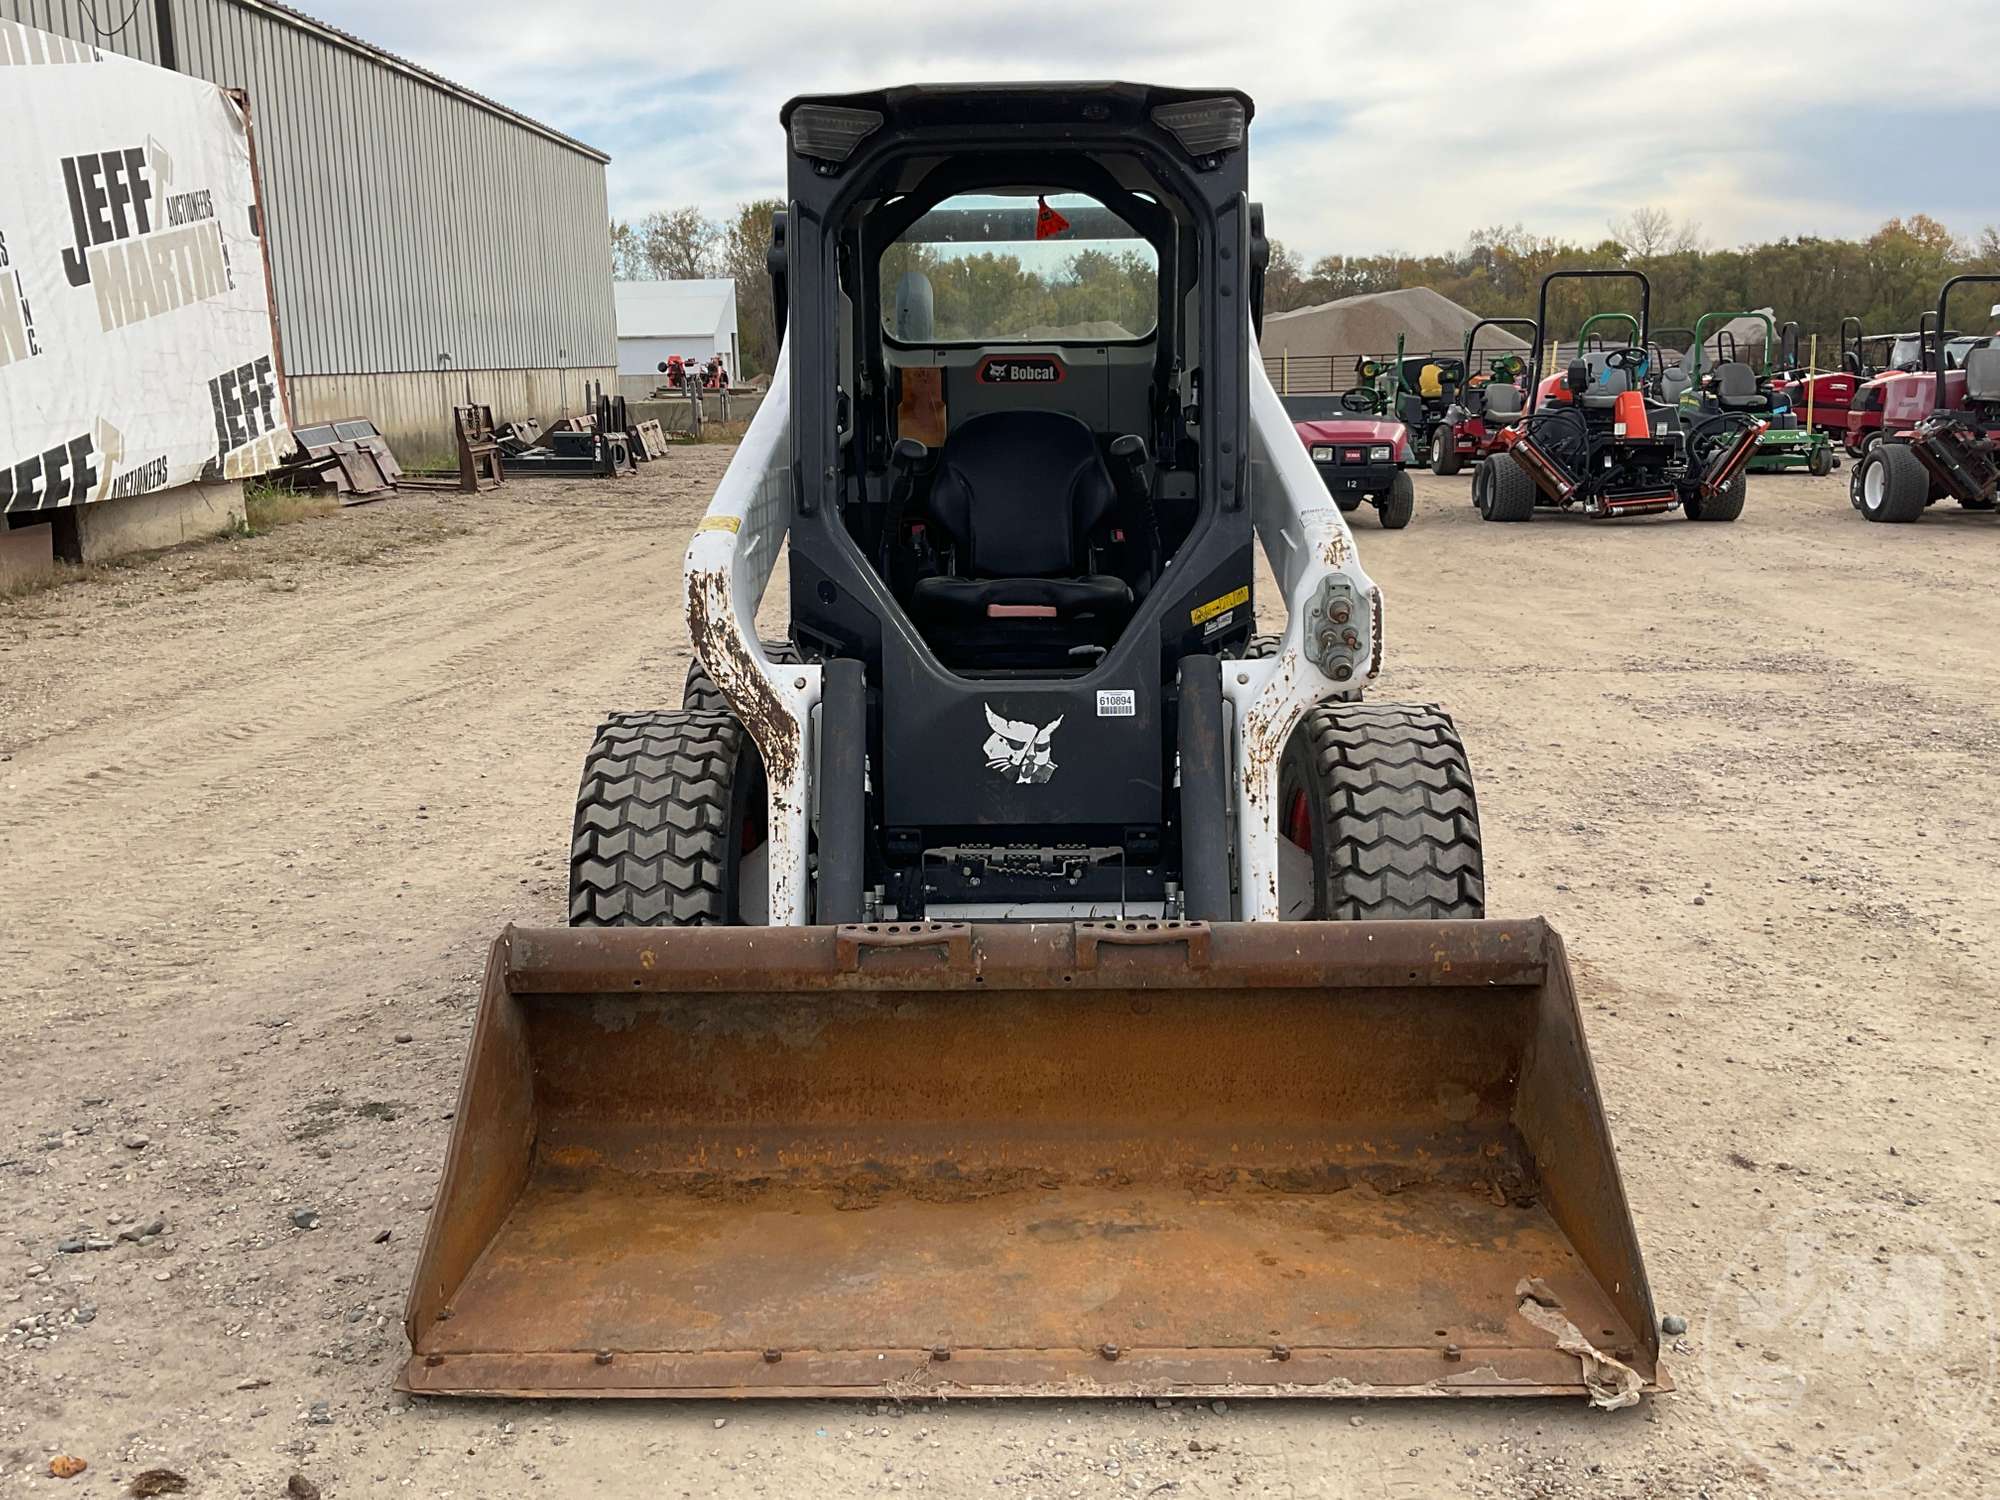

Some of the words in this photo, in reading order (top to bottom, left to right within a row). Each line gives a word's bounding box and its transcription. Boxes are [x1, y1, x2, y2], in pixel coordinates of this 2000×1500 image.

[60, 147, 152, 288] JEFF
[166, 189, 214, 227] AUCTIONEERS
[87, 221, 228, 333] MARTIN
[1010, 366, 1054, 380] Bobcat
[200, 354, 275, 481] JEFF
[111, 455, 168, 500] AUCTIONEERS
[1347, 480, 1357, 488] 12
[1100, 696, 1131, 705] 610894
